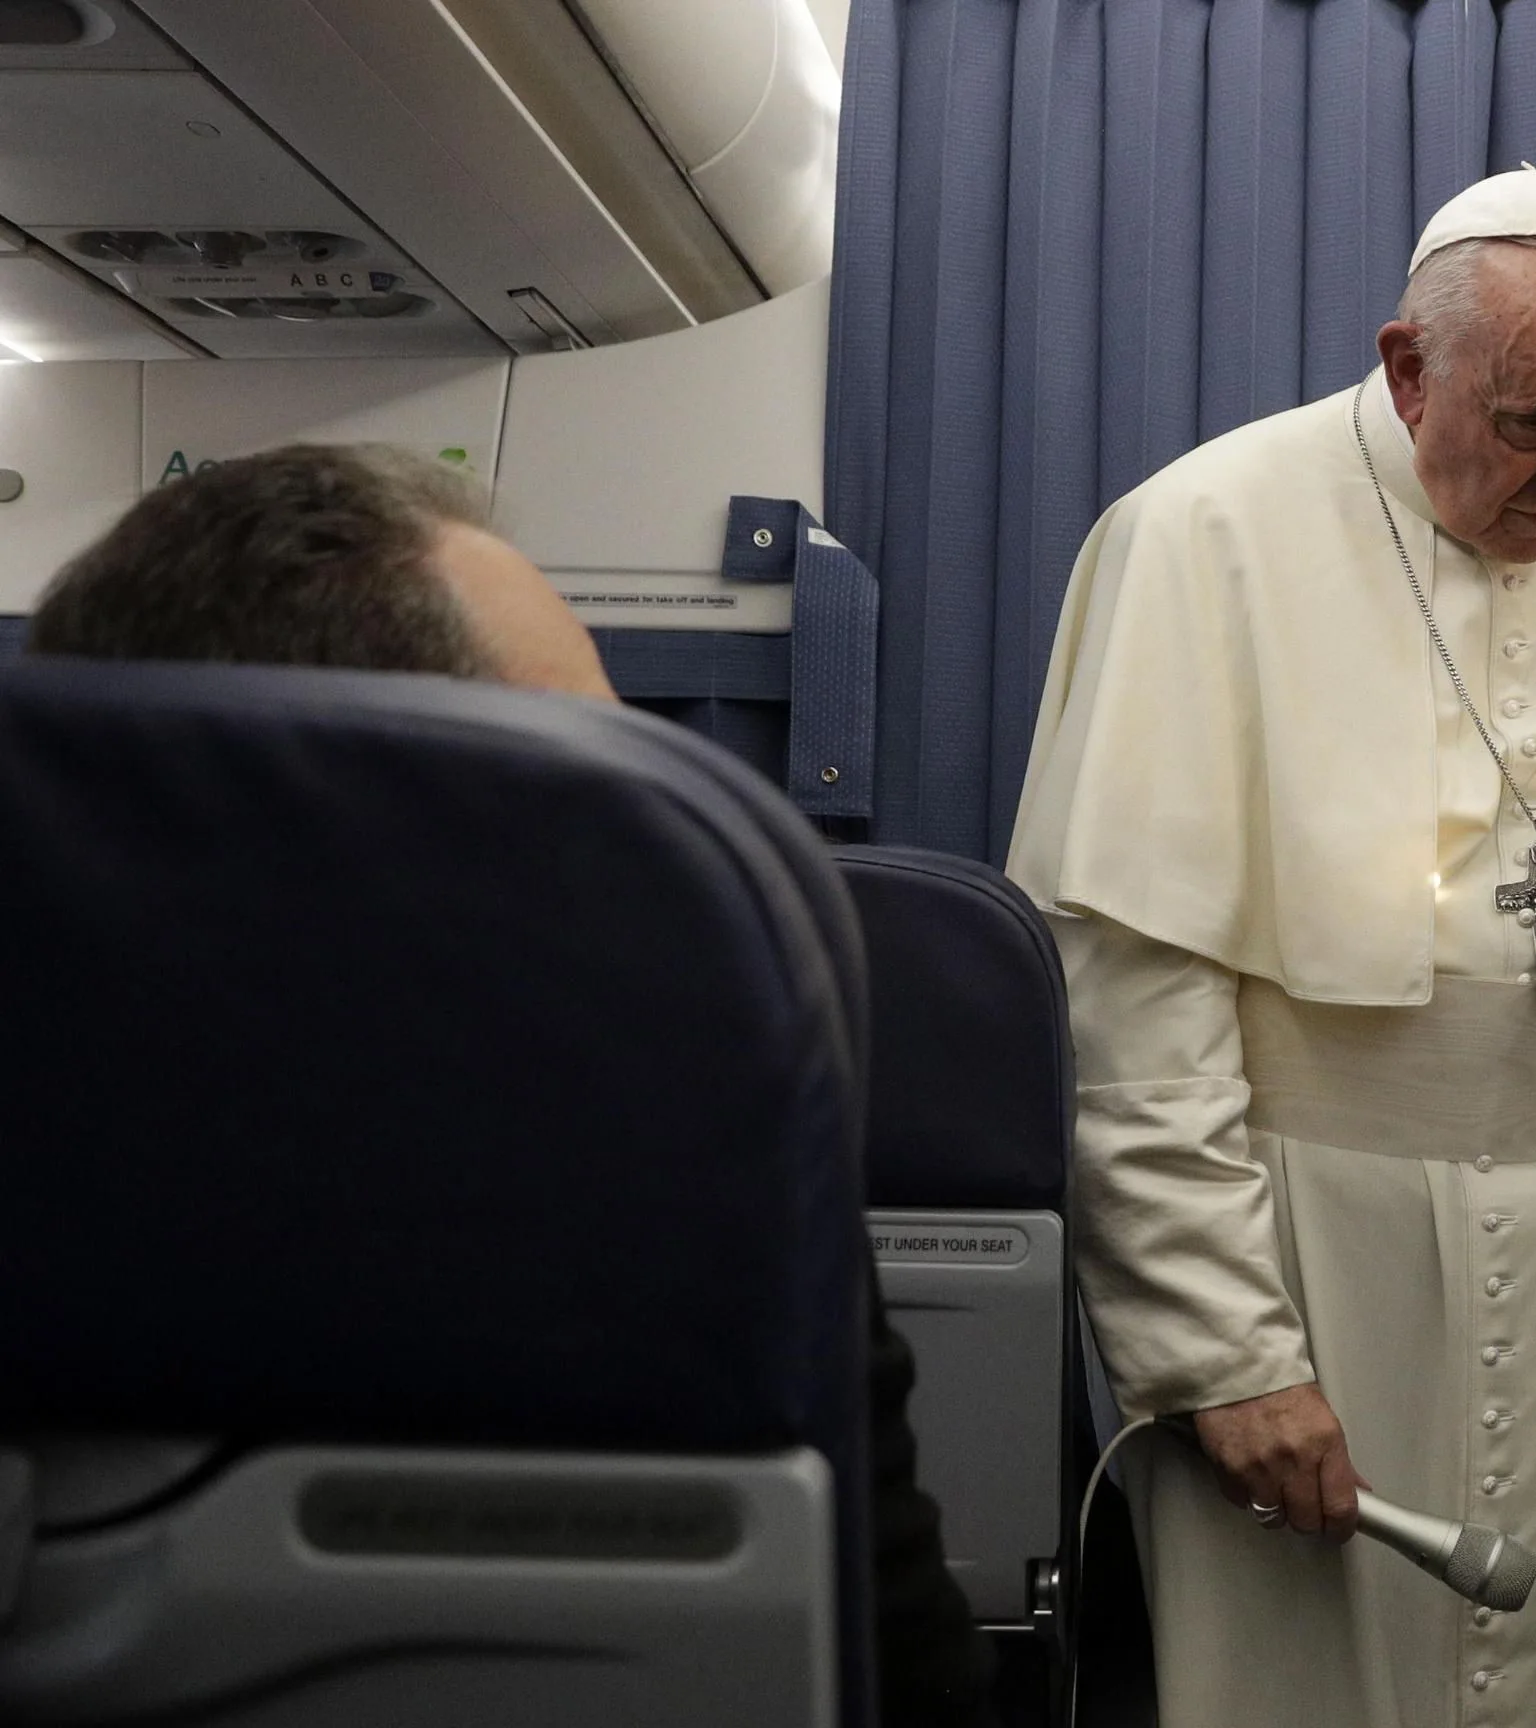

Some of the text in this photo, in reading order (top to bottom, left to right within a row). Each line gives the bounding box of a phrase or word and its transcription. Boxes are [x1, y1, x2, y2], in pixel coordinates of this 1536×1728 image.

[289, 273, 354, 287] A B C
[158, 450, 228, 486] Ae
[869, 1236, 1013, 1253] ST UNDER YOUR SEAT
